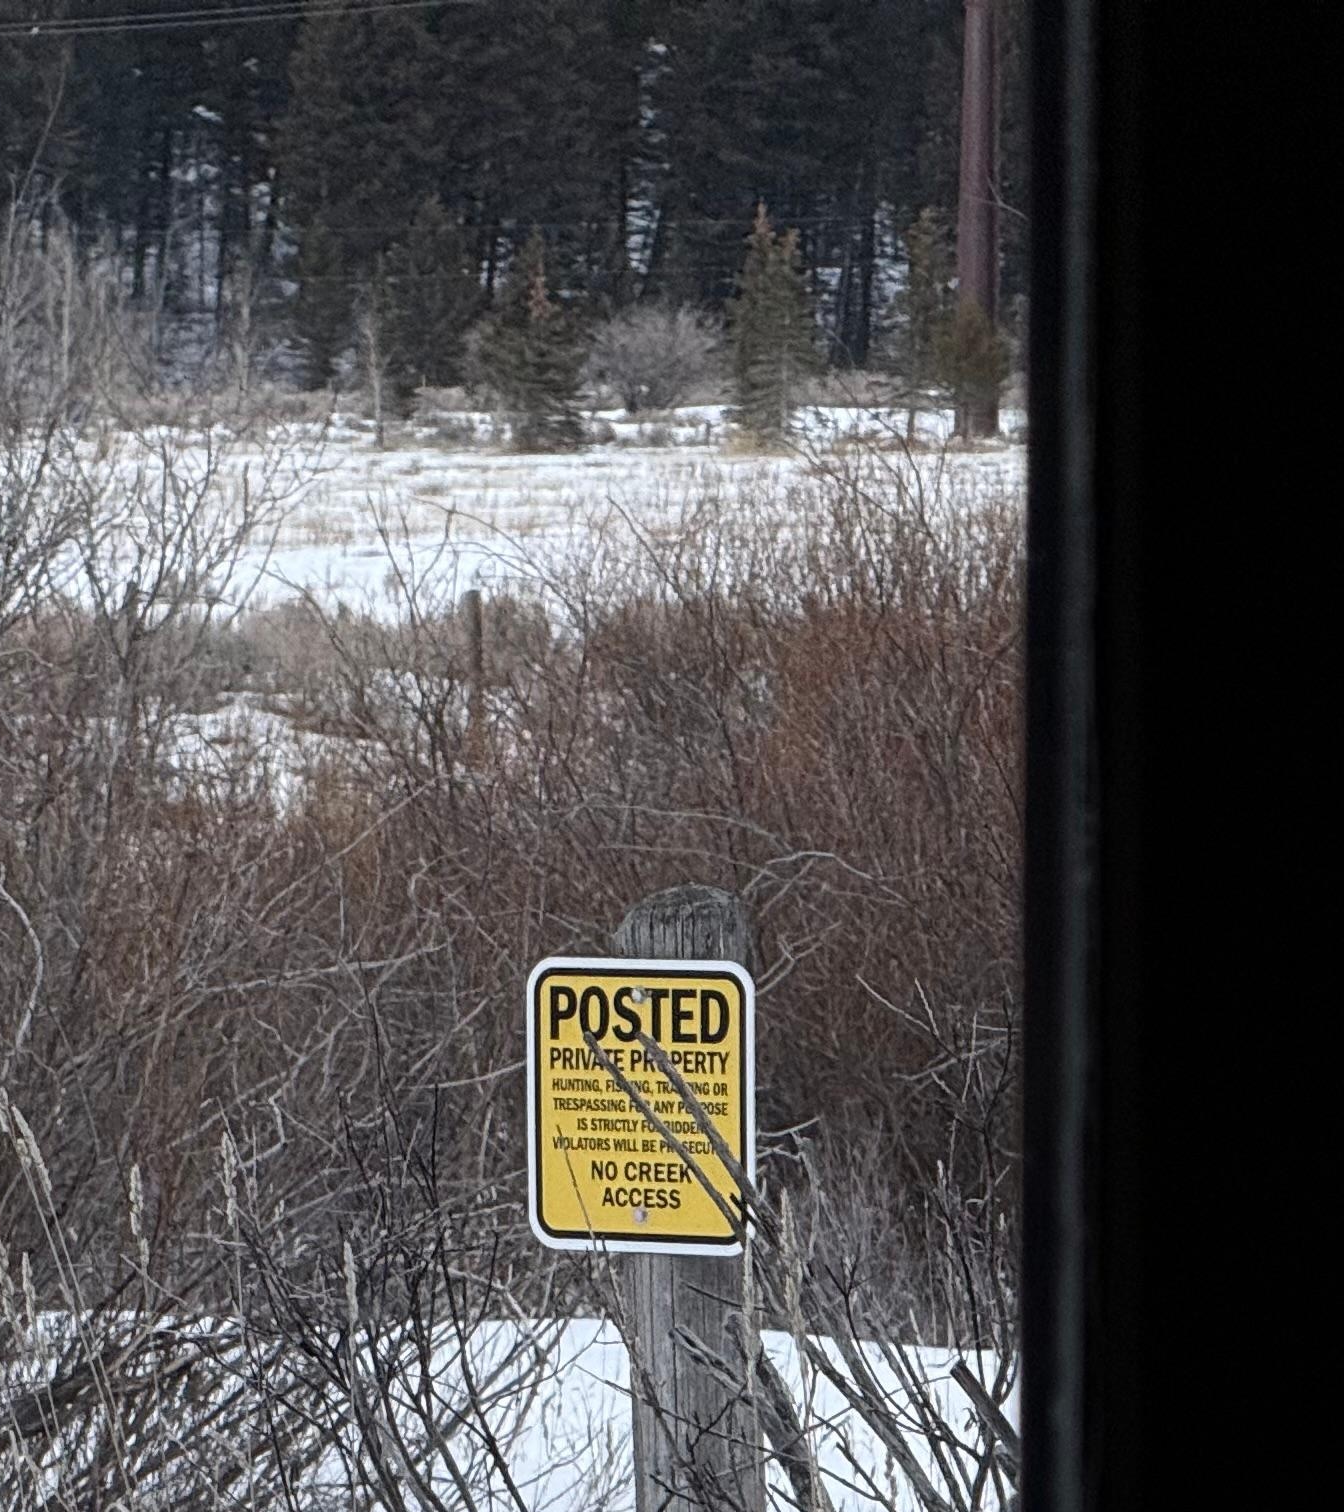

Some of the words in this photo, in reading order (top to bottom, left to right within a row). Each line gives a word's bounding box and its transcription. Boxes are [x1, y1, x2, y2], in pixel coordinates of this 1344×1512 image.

[550, 986, 730, 1044] POSTED
[550, 1047, 625, 1071] PRIVATE
[630, 1049, 730, 1075] PRPERTY
[552, 1078, 603, 1095] HUNTING,
[606, 1079, 653, 1096] FISNG,
[656, 1081, 710, 1096] TRAING
[713, 1082, 728, 1097] OR
[553, 1097, 626, 1113] TRESPASSING
[654, 1100, 676, 1114] ANY
[678, 1101, 728, 1116] PUPOSE
[577, 1117, 588, 1131] IS
[590, 1118, 638, 1132] STRICTLY
[641, 1119, 705, 1134] FOBIDDE
[552, 1136, 611, 1151] VIOLATORS
[613, 1138, 639, 1152] WILL
[642, 1140, 657, 1153] BE
[591, 1160, 618, 1181] NO
[624, 1161, 692, 1184] CREEK
[602, 1187, 681, 1209] ACCESS
